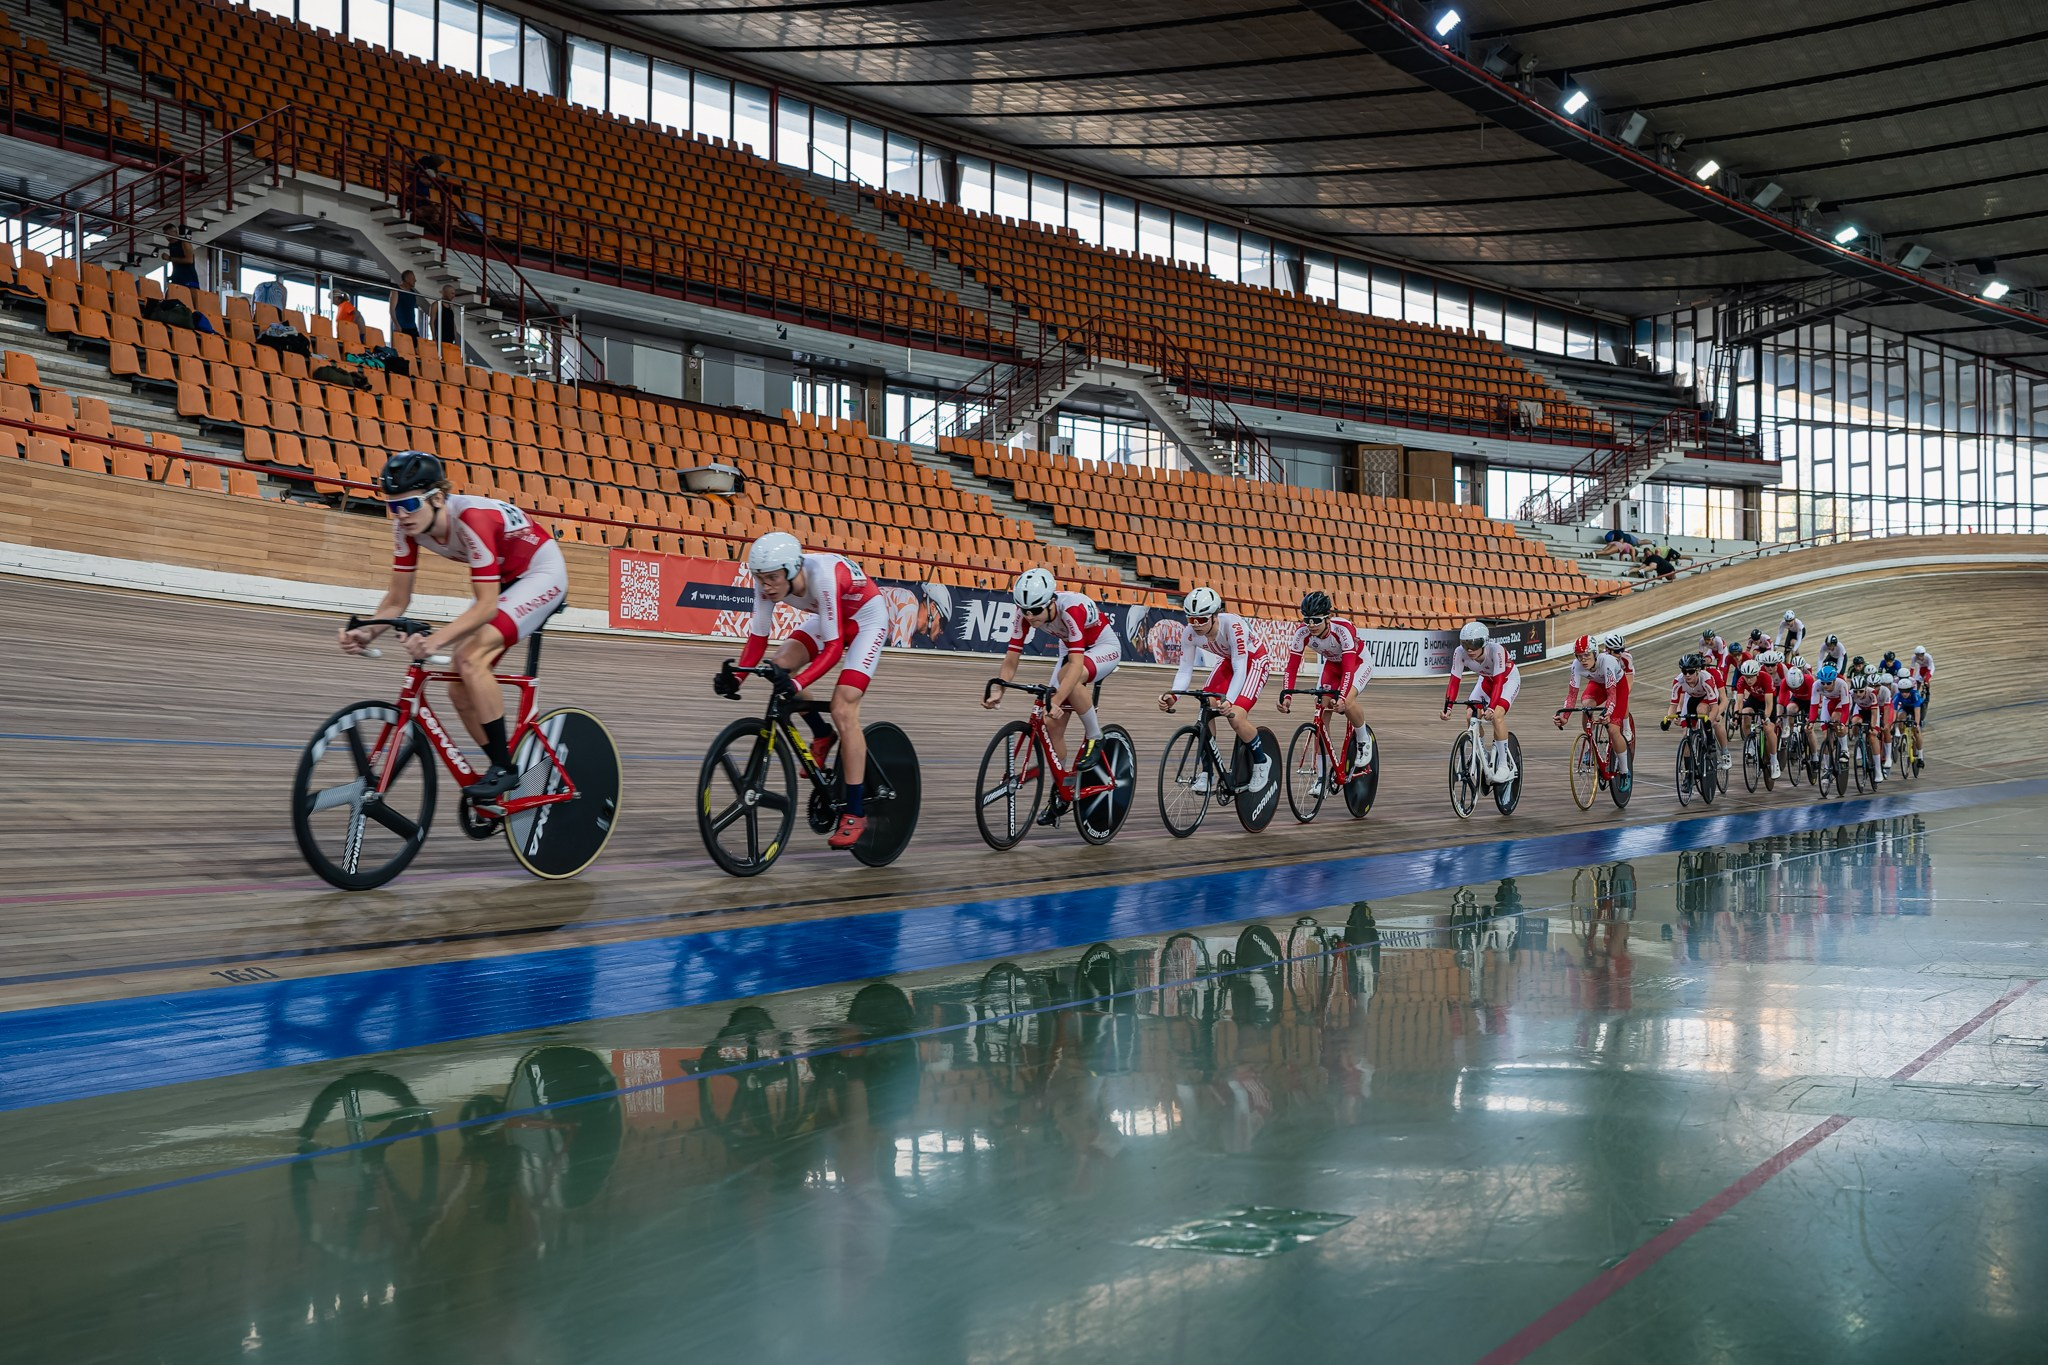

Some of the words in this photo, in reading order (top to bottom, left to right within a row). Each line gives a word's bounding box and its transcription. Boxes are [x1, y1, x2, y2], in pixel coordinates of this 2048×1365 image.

[699, 591, 757, 604] www.nbs-cyclin
[955, 599, 1037, 644] NB
[862, 627, 887, 669] МОСКВА
[1364, 640, 1419, 668] PECIALIZED
[1430, 639, 1456, 651] наличи
[1523, 643, 1543, 655] PLANCHE
[1209, 736, 1224, 773] BMC
[1252, 780, 1278, 821] CORIMA
[209, 966, 280, 983] 160
